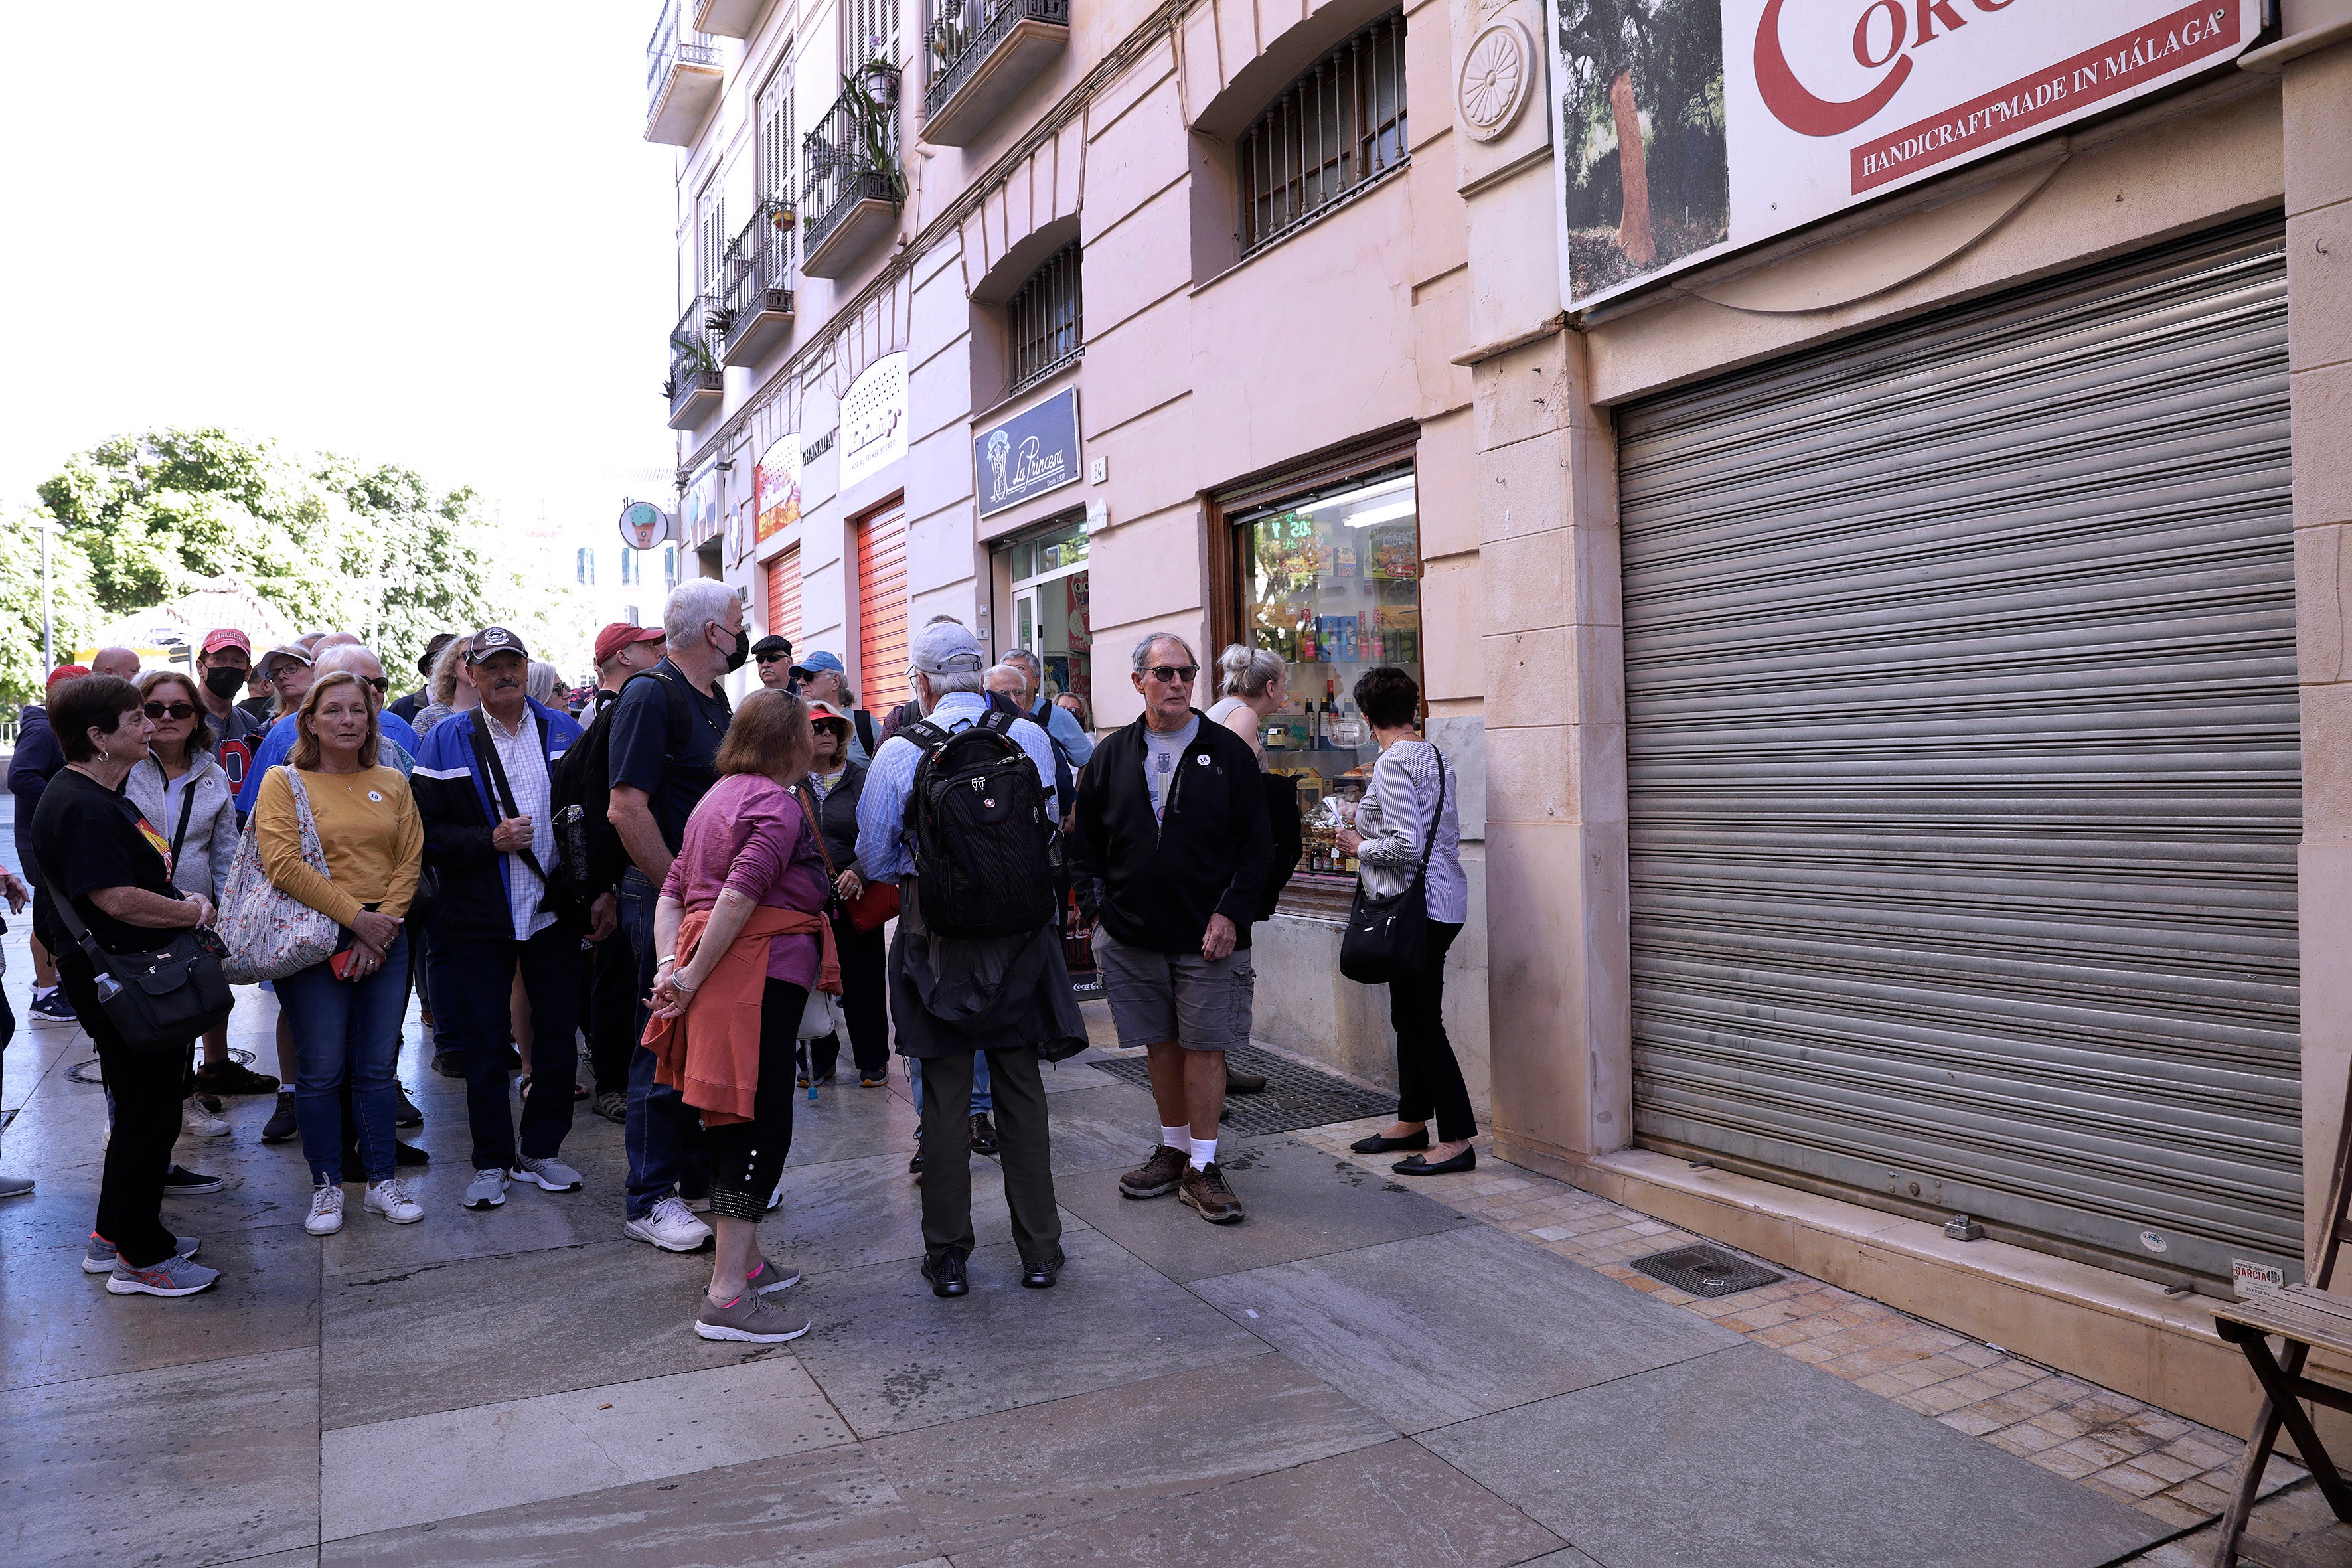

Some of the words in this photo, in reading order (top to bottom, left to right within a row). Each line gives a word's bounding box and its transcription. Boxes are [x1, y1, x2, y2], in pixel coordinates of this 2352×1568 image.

[1861, 105, 1993, 177] HANDICRAFT
[1999, 75, 2067, 122] MADE
[2073, 61, 2099, 94] IN
[2104, 15, 2224, 81] MÁLAGA
[802, 431, 834, 466] GRANADA
[1018, 435, 1063, 493] Princesa
[1094, 463, 1102, 479] 84
[1047, 477, 1057, 487] Desde
[2235, 1266, 2267, 1282] GARCIA
